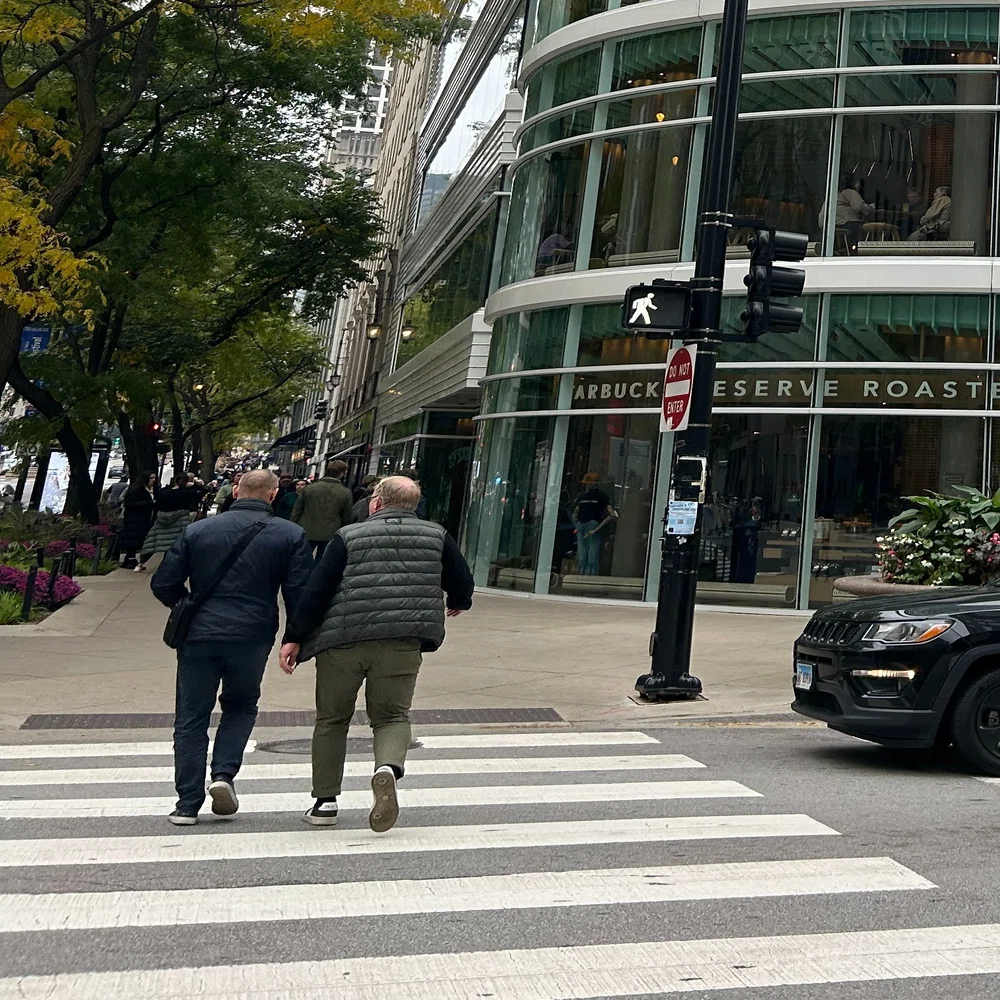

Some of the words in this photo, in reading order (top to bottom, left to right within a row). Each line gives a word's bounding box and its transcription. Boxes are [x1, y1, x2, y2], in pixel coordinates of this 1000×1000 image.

[668, 365, 677, 378] DO
[679, 362, 691, 377] NOT
[572, 381, 660, 401] ARBUCK
[713, 379, 838, 398] ESERVE
[666, 400, 684, 414] ENTER
